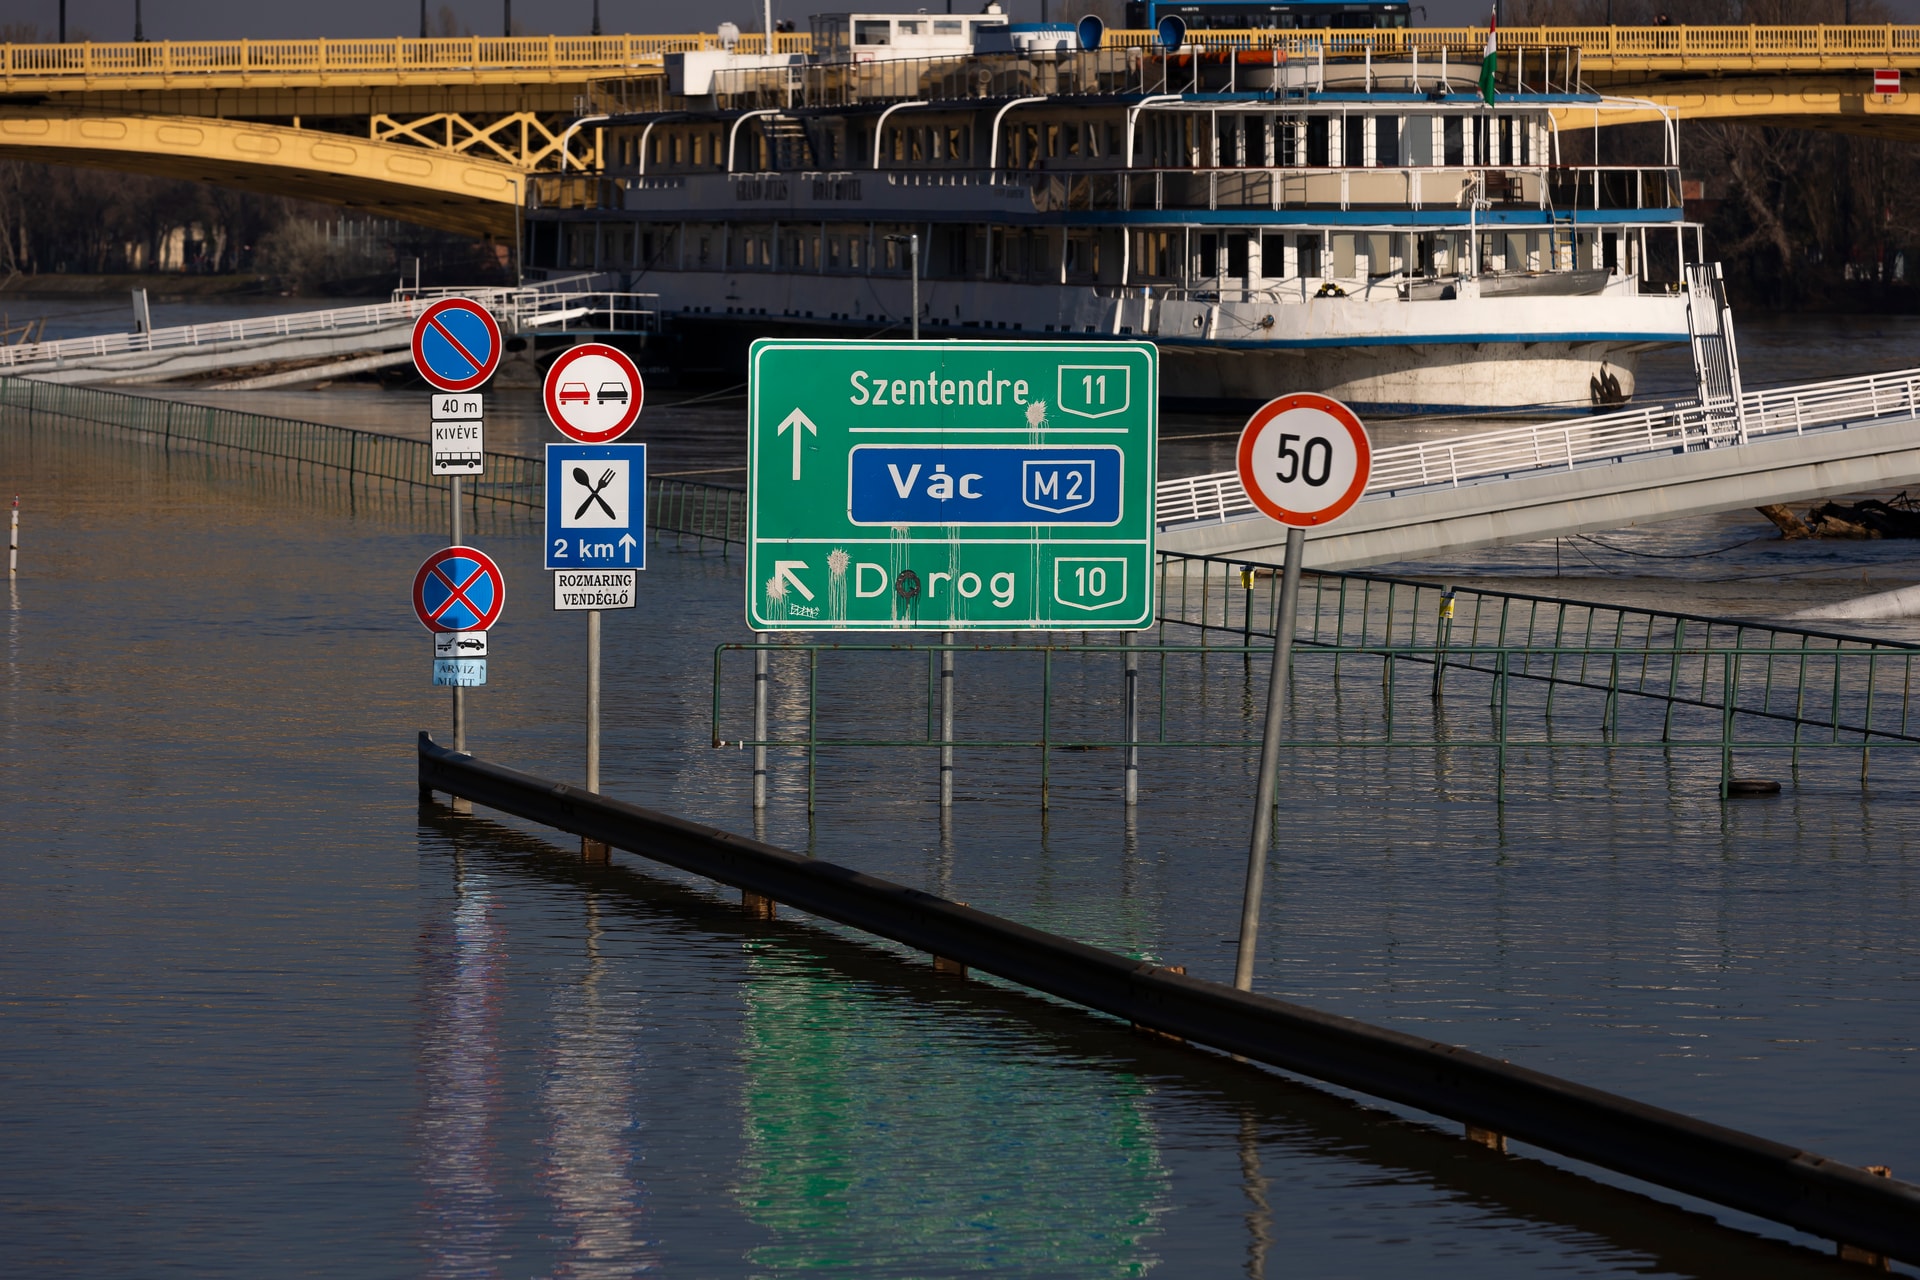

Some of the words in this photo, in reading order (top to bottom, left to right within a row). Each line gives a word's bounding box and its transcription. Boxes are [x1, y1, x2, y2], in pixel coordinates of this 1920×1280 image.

[849, 370, 1029, 406] Szentendre
[1082, 375, 1105, 404] 11
[442, 398, 459, 413] 40
[464, 402, 478, 413] m
[436, 425, 478, 440] KIVÉVE
[1276, 433, 1333, 487] 50
[887, 464, 984, 500] Vác
[553, 538, 569, 558] 2
[579, 538, 614, 558] km
[559, 574, 632, 587] ROZMARING
[855, 562, 1015, 608] Dorog
[1075, 566, 1106, 597] 10
[562, 589, 629, 606] VENDÉGLŐ
[439, 662, 475, 675] ÁRVÍZ
